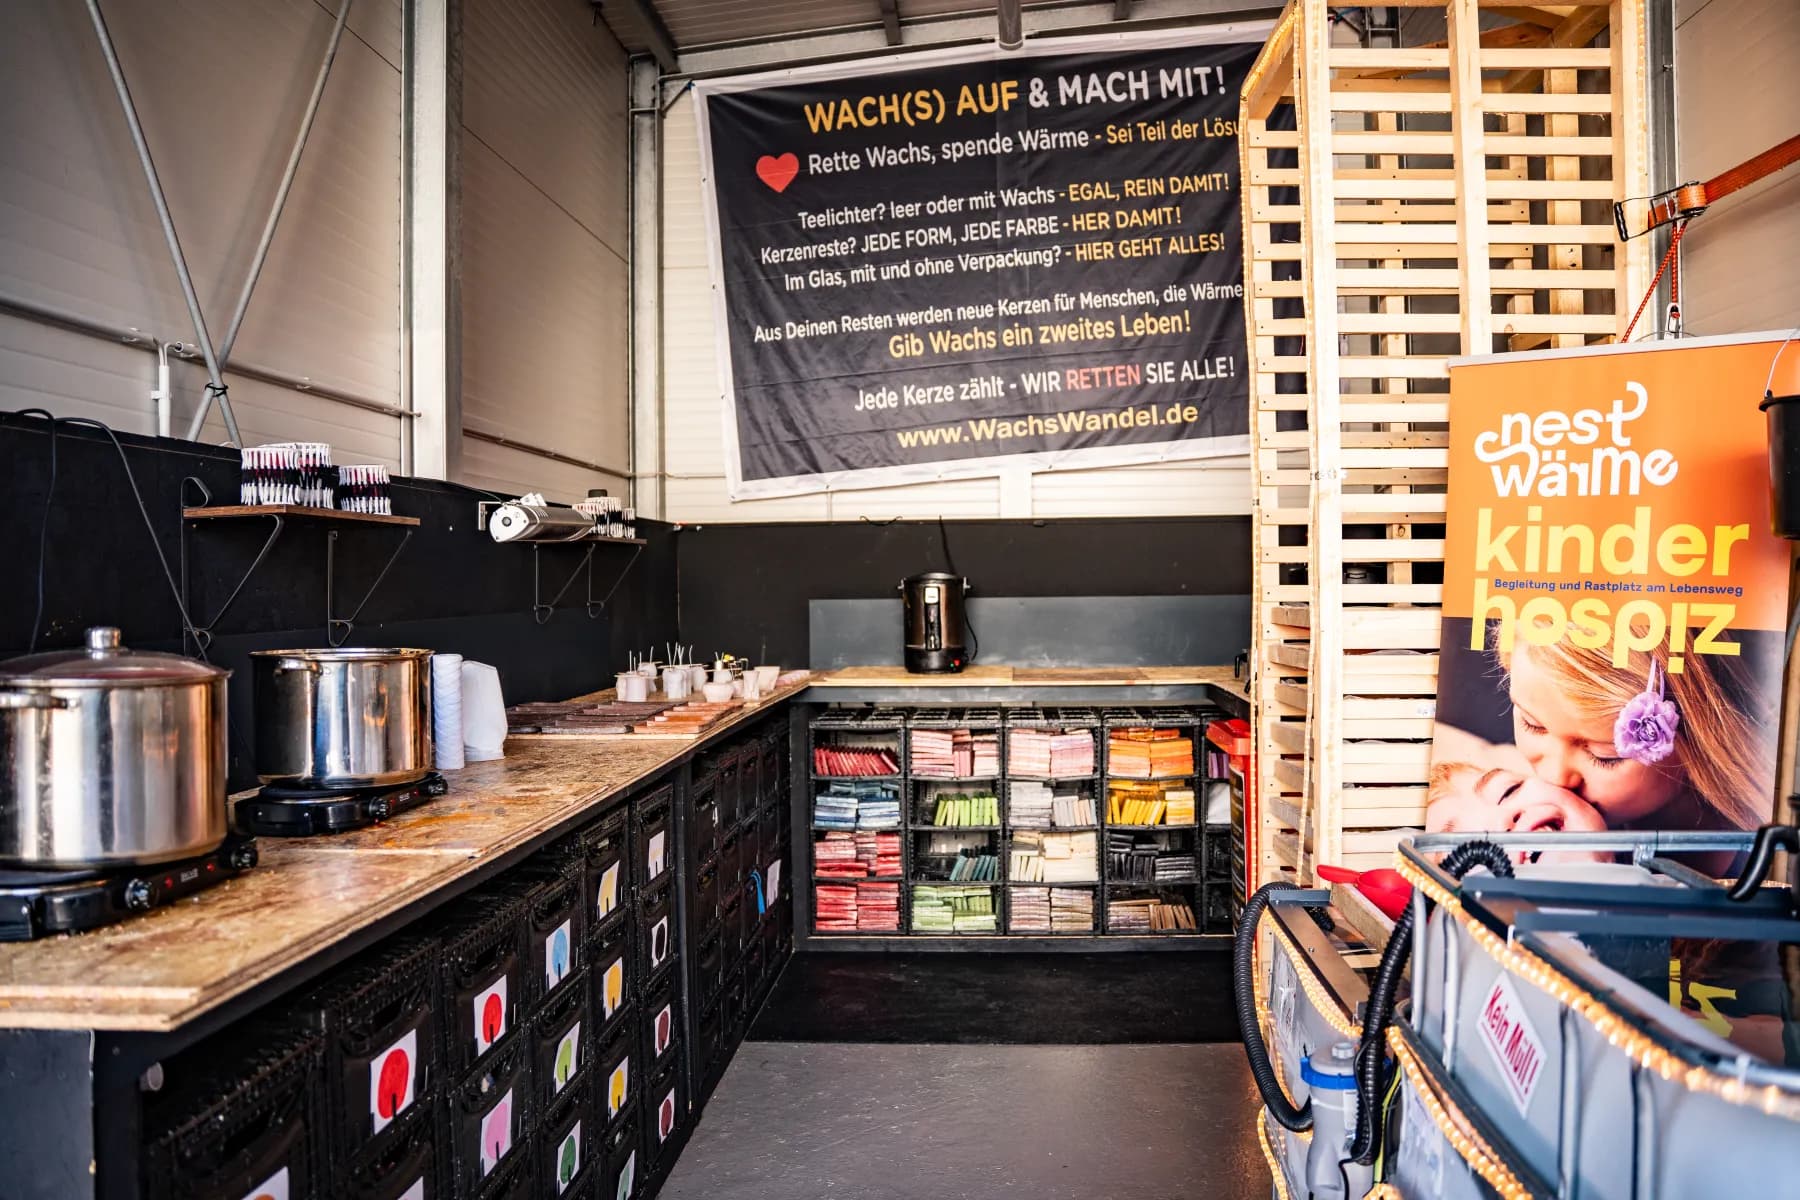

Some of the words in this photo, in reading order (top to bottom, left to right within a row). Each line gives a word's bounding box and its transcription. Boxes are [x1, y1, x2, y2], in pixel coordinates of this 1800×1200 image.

[804, 89, 945, 134] WACH(S)
[957, 81, 1018, 116] AUF
[1029, 77, 1049, 108] &
[1058, 70, 1149, 106] MACH
[1159, 66, 1226, 99] MIT!
[808, 152, 860, 175] Rette
[866, 142, 936, 168] Wachs,
[942, 132, 1013, 164] spende
[1019, 129, 1089, 151] Wärme
[1106, 123, 1133, 144] Sei
[1137, 121, 1166, 141] Teil
[1171, 119, 1198, 139] der
[798, 203, 885, 229] Teelichter?
[890, 200, 921, 219] leer
[926, 196, 963, 215] oder
[969, 192, 996, 211] mit
[1000, 186, 1055, 207] Wachs
[1069, 182, 1120, 202] EGAL,
[1124, 178, 1165, 198] REIN
[1170, 173, 1229, 194] DAMIT!
[761, 237, 856, 264] Kerzenreste?
[861, 232, 900, 253] JEDE
[905, 227, 957, 248] FORM,
[961, 222, 1001, 242] JEDE
[1006, 216, 1059, 237] FARBE
[1072, 212, 1110, 231] HER
[1115, 206, 1182, 229] DAMIT!
[785, 274, 804, 291] Im
[809, 269, 846, 289] Glas,
[851, 265, 876, 284] mit
[881, 261, 910, 280] und
[915, 257, 954, 276] ohne
[958, 246, 1061, 272] Verpackung?
[1075, 241, 1114, 261] HIER
[1119, 237, 1163, 257] GEHT
[1168, 232, 1225, 253] ALLES!
[754, 325, 782, 343] Aus
[786, 319, 837, 339] Deinen
[842, 312, 893, 332] Resten
[897, 307, 952, 327] werden
[957, 302, 993, 320] neue
[999, 298, 1050, 317] Kerzen
[1054, 293, 1075, 312] für
[1080, 287, 1159, 309] Menschen,
[1163, 284, 1187, 303] die
[1191, 282, 1243, 301] Wärme
[889, 336, 923, 358] Gib
[930, 327, 997, 352] Wachs
[1002, 322, 1033, 347] ein
[1039, 317, 1115, 344] zweites
[1120, 310, 1190, 337] Leben!
[854, 387, 898, 411] Jede
[903, 385, 954, 406] Kerze
[959, 376, 1004, 400] zählt
[1021, 372, 1061, 394] WIR
[1066, 364, 1141, 391] RETTEN
[1146, 362, 1175, 384] SIE
[1180, 356, 1235, 381] ALLE!
[897, 403, 1198, 448] www.WachsWandel.de
[1501, 381, 1648, 447] nest
[1490, 446, 1678, 498] wärme
[1475, 505, 1750, 577] kinder
[1494, 579, 1556, 592] Begleitung
[1560, 581, 1580, 590] und
[1585, 581, 1642, 592] Rastplatz
[1646, 584, 1665, 592] am
[1670, 583, 1743, 597] Lebensweg
[1485, 985, 1510, 1045] Kein
[1504, 1022, 1539, 1095] Müll!
